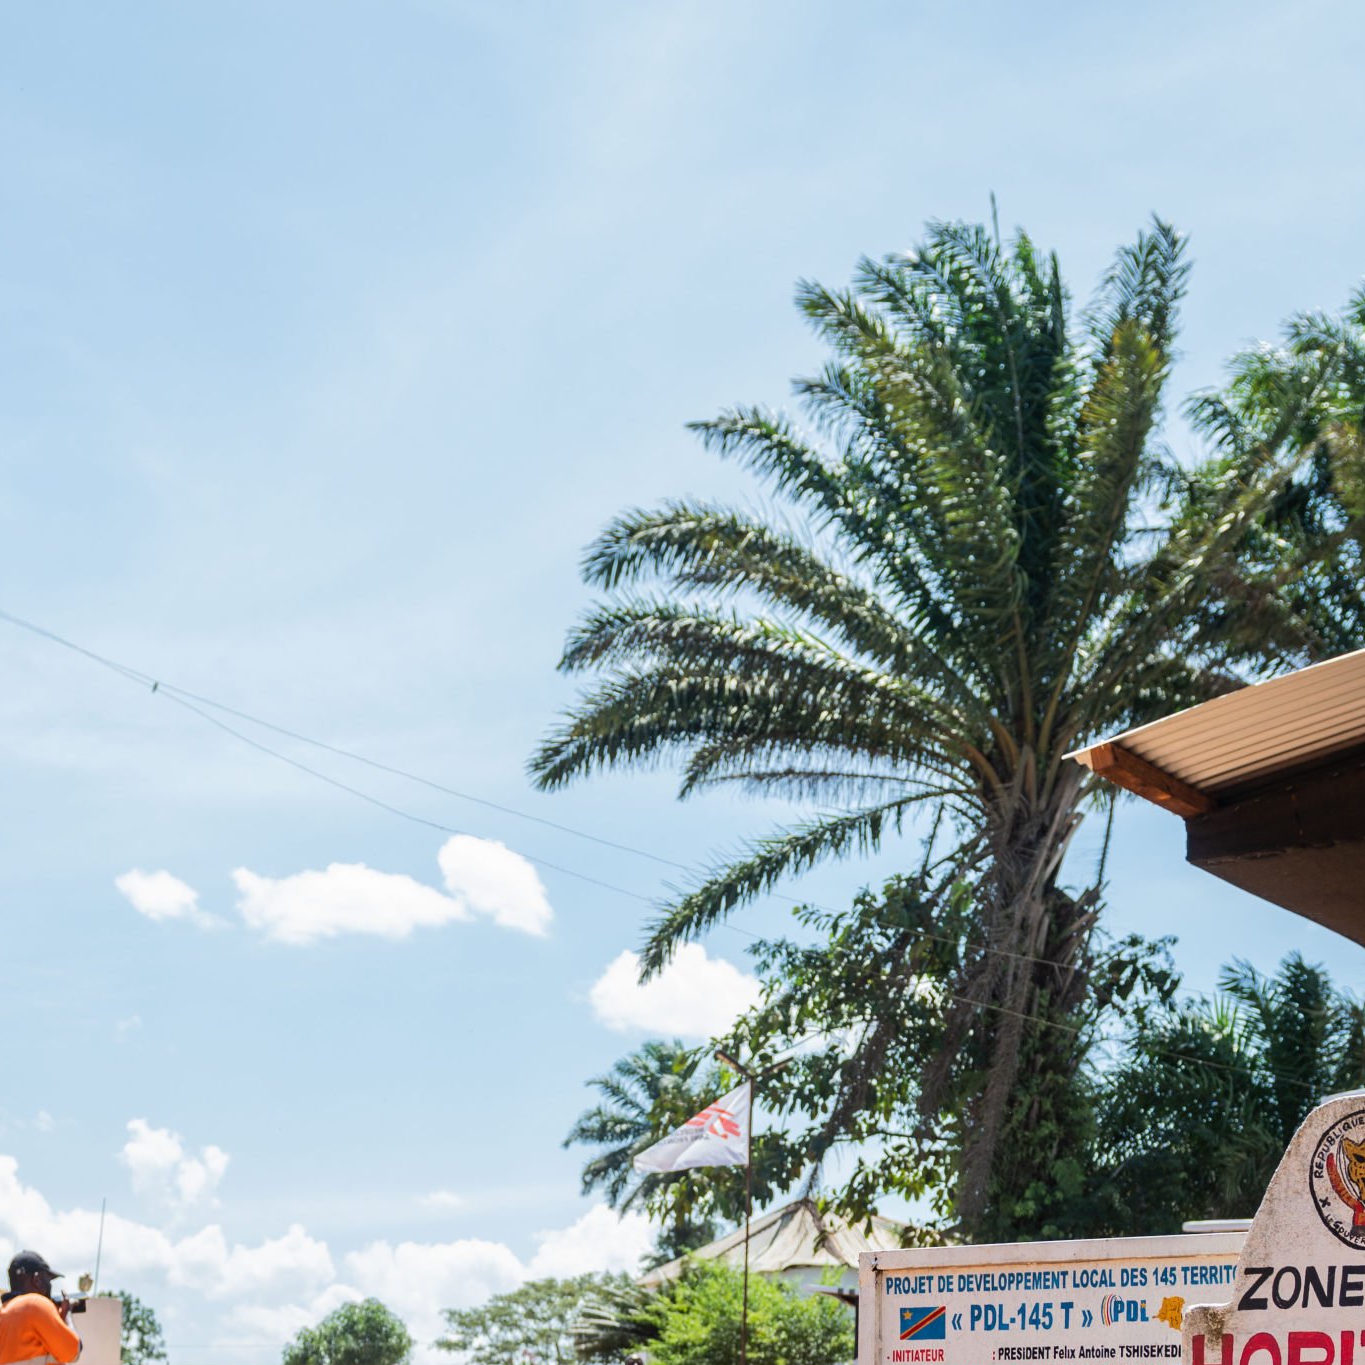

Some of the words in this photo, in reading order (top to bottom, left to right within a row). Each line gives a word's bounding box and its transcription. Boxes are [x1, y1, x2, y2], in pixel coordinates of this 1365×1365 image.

[1314, 1116, 1365, 1178] REPUBLIQUE
[886, 1275, 934, 1295] PROJET
[937, 1274, 954, 1293] DE
[958, 1270, 1069, 1293] DEVELOPPEMENT
[1072, 1268, 1116, 1289] LOCAL
[1120, 1267, 1148, 1288] DES
[1152, 1266, 1177, 1286] 145
[1238, 1265, 1365, 1311] ZONE
[970, 1302, 1054, 1332] PDL-145
[1060, 1301, 1074, 1330] T
[1113, 1299, 1149, 1323] PDL
[892, 1349, 945, 1363] INITIATEUR
[1078, 1345, 1116, 1359] Antoine
[1119, 1344, 1182, 1358] TSHISEKEDI
